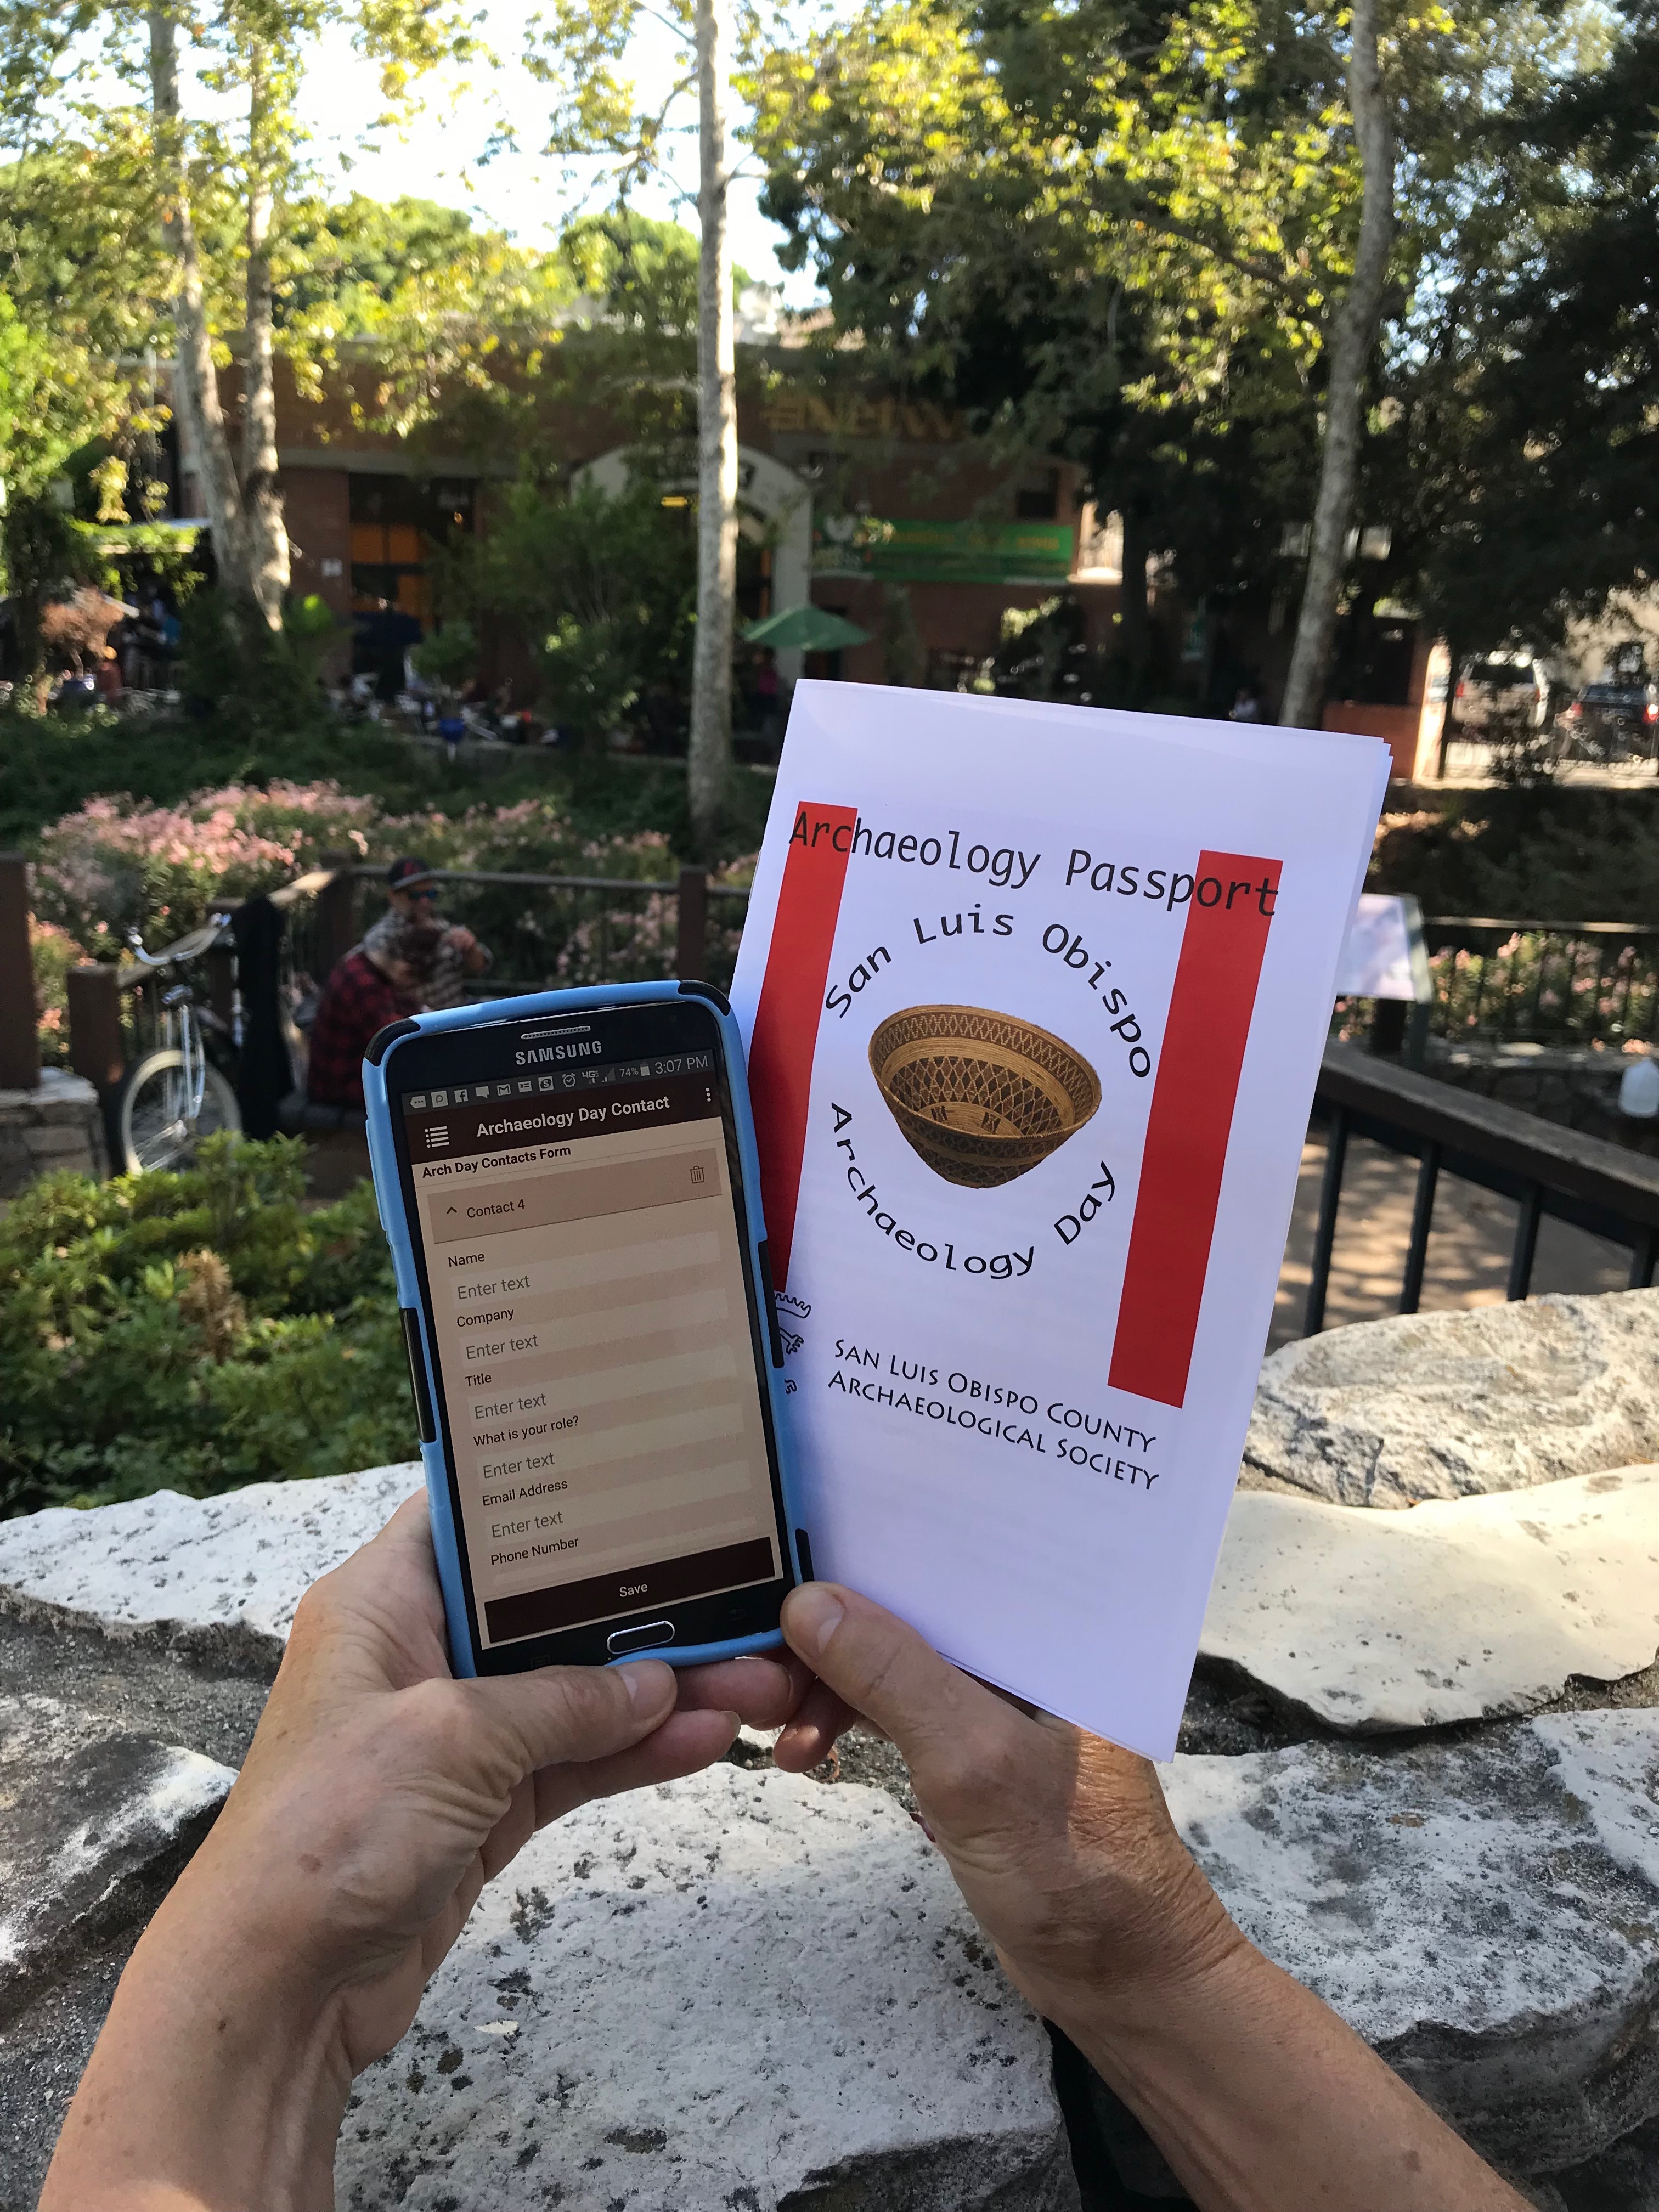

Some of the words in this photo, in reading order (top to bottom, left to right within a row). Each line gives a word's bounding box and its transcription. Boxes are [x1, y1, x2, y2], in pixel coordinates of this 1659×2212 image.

[788, 811, 1041, 890] Archaeology
[1065, 848, 1279, 917] Passport
[825, 946, 893, 1019] San
[913, 903, 1014, 945] Luis
[1042, 923, 1151, 1078] Obispo
[515, 1040, 602, 1065] SAMSUNG
[619, 1067, 639, 1077] 74%
[654, 1059, 682, 1074] 3:07
[686, 1055, 708, 1070] PM
[476, 1111, 574, 1138] Archaeology
[578, 1107, 607, 1124] Day
[611, 1095, 670, 1117] Contact
[422, 1163, 452, 1179] Arch
[454, 1159, 479, 1176] Day
[481, 1150, 537, 1170] Contacts
[539, 1145, 571, 1160] Form
[831, 1101, 1035, 1280] Archaeology
[1053, 1160, 1116, 1245] Day
[466, 1200, 515, 1219] Contact
[517, 1199, 526, 1210] 4
[448, 1253, 485, 1267] Name
[457, 1281, 497, 1300] Enter
[500, 1275, 531, 1292] text
[456, 1308, 514, 1327] Company
[466, 1342, 505, 1359] Enter
[509, 1334, 539, 1351] text
[464, 1373, 492, 1387] Title
[475, 1401, 514, 1419] Enter
[517, 1393, 548, 1410] text
[834, 1338, 881, 1370] SAN
[889, 1354, 939, 1386] LUIS
[947, 1372, 1039, 1414] OBISPO
[1047, 1402, 1156, 1452] COUNTY
[473, 1431, 506, 1447] What
[508, 1429, 519, 1439] is
[521, 1423, 548, 1440] your
[550, 1415, 579, 1431] role?
[828, 1370, 1046, 1453] ARCHAEOLOGICAL
[1056, 1438, 1160, 1489] SOCIETY
[483, 1460, 522, 1479] Enter
[526, 1452, 555, 1470] text
[482, 1489, 516, 1506] Email
[518, 1480, 568, 1499] Address
[491, 1519, 531, 1538] Enter
[534, 1511, 564, 1529] text
[490, 1549, 529, 1566] Phone
[532, 1538, 579, 1556] Number
[619, 1582, 648, 1598] Save
